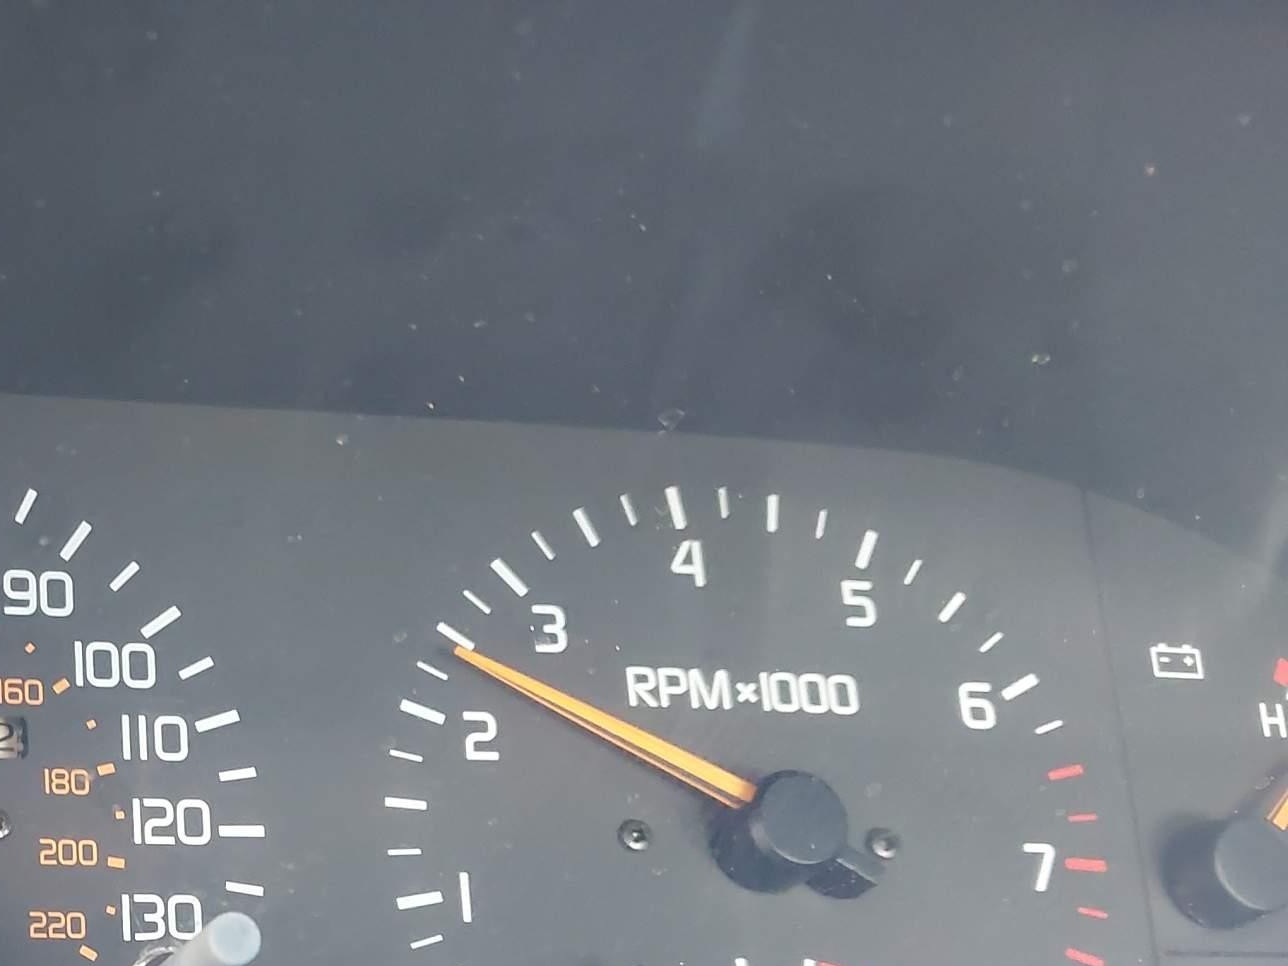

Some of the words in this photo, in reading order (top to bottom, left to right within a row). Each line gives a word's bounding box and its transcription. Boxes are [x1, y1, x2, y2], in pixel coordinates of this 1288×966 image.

[670, 540, 706, 587] 4
[3, 569, 74, 617] 90
[840, 579, 877, 627] 5
[531, 604, 568, 653] 3
[74, 640, 156, 689] 100
[958, 681, 997, 730] 6
[1258, 702, 1288, 738] H
[121, 714, 189, 762] 110
[462, 711, 500, 761] 2
[44, 768, 91, 796] 180
[132, 797, 212, 846] 120
[39, 838, 98, 866] 200
[1022, 842, 1056, 892] 7
[118, 892, 204, 943] 130
[459, 871, 472, 923] 1
[29, 911, 86, 939] 220
